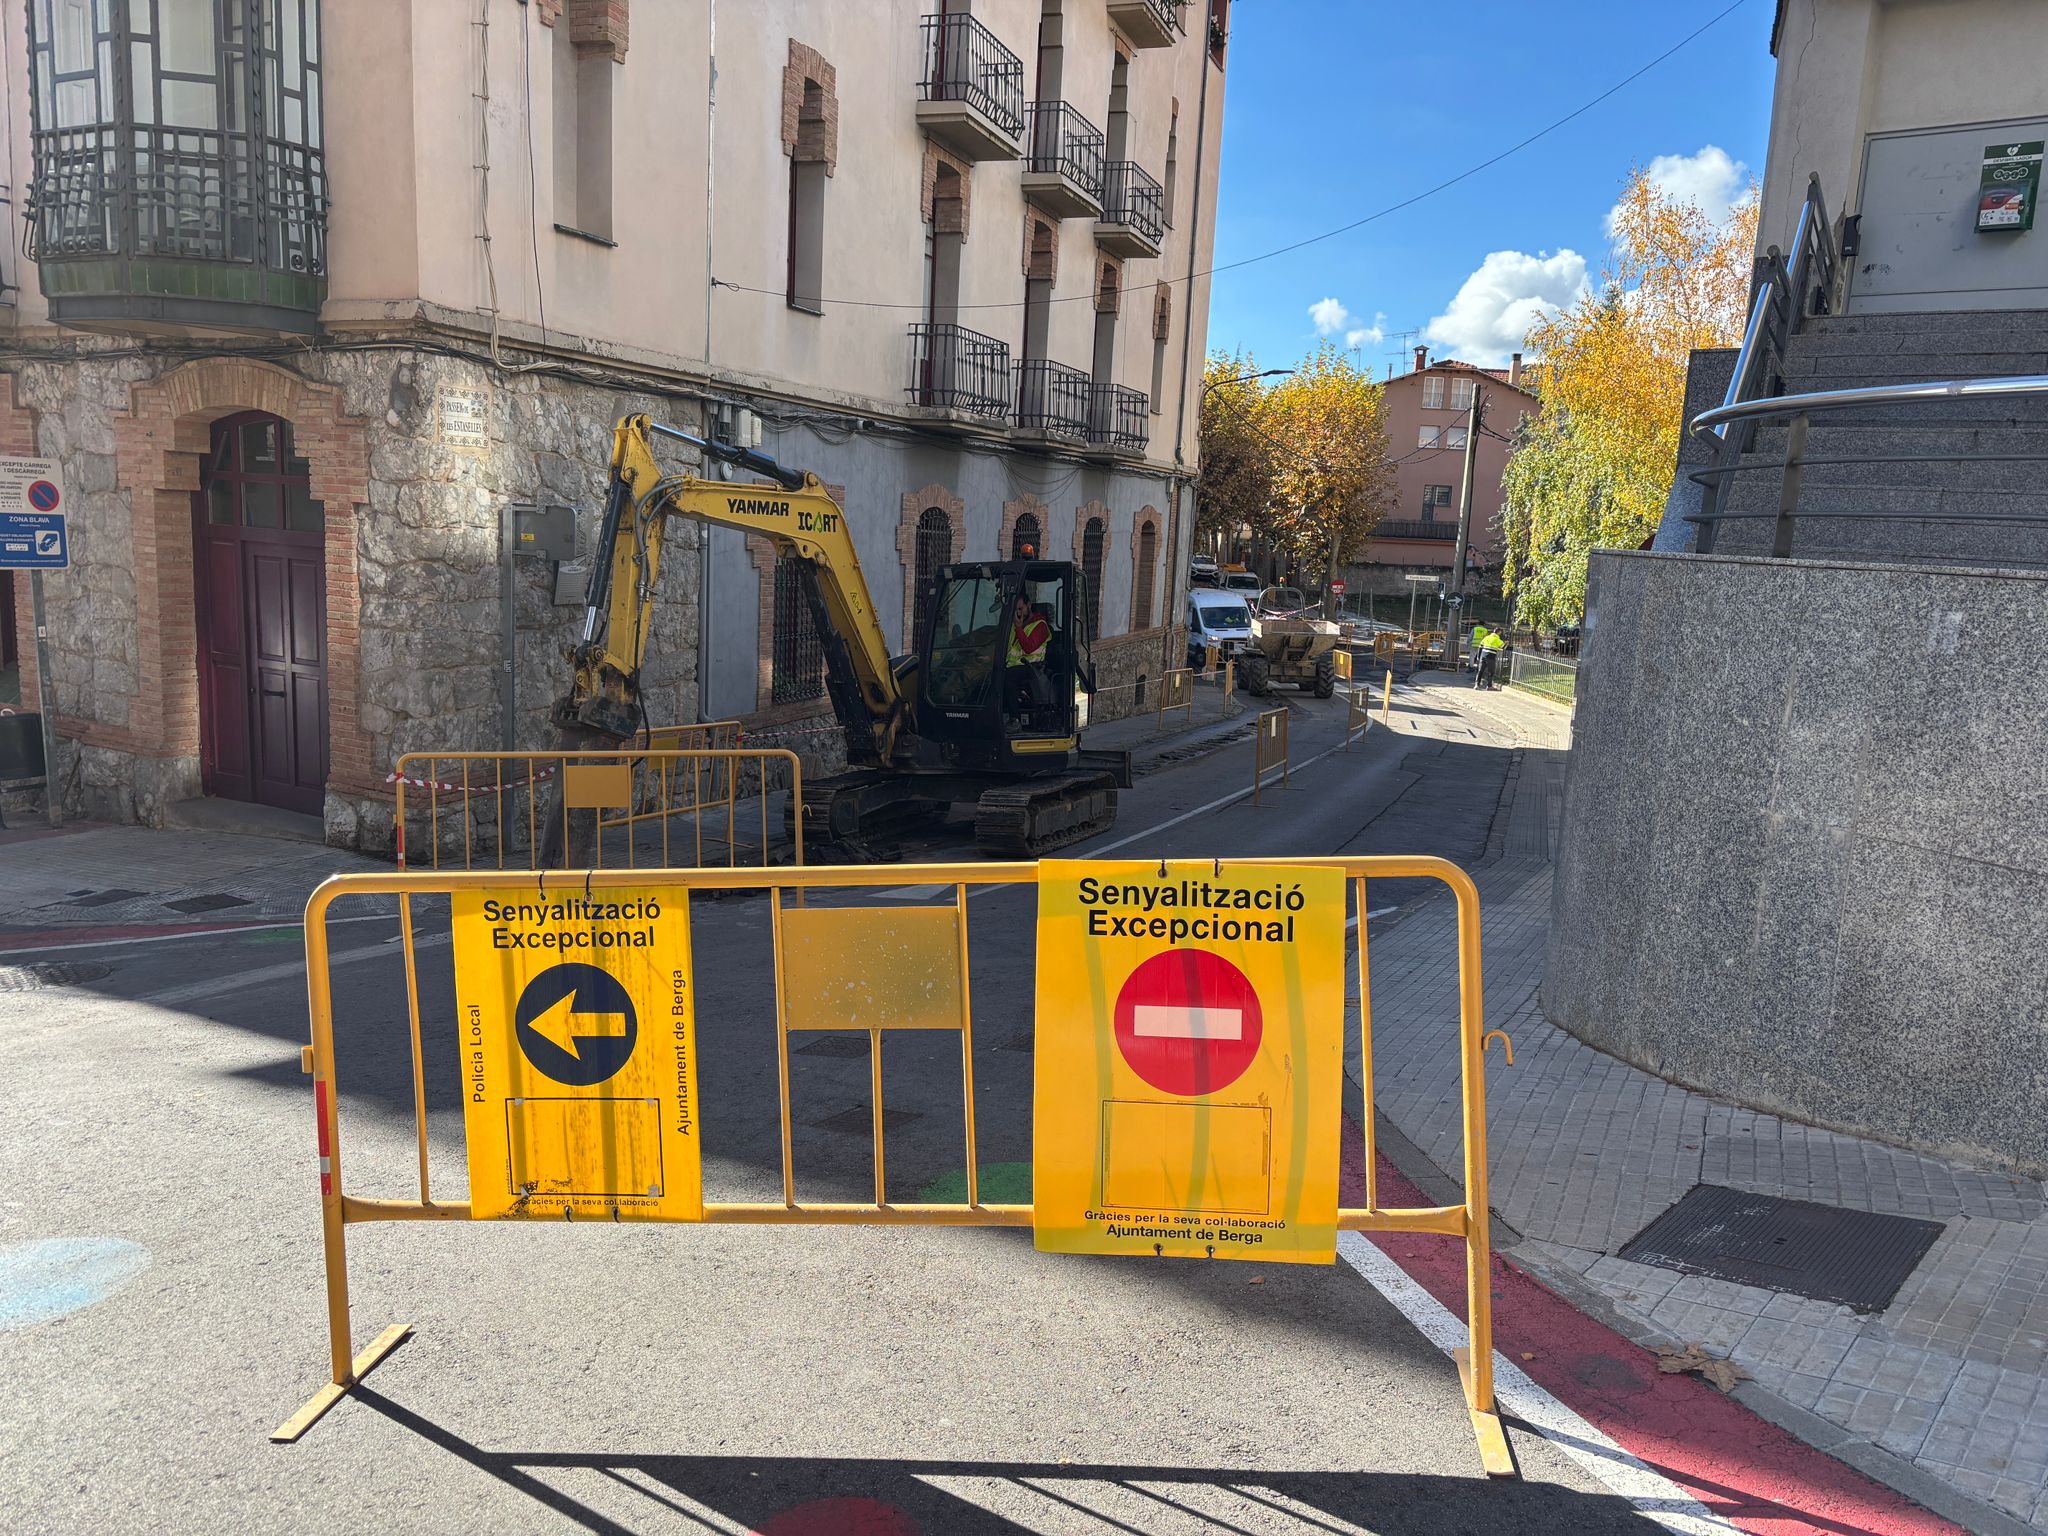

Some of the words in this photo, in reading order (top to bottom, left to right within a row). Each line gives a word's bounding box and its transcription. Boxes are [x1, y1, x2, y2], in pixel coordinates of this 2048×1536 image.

[727, 498, 790, 516] YANMAR
[798, 512, 838, 533] ICART
[1078, 878, 1305, 912] Senyalització
[483, 897, 661, 926] Senyalització
[492, 926, 655, 953] Excepcional
[1088, 909, 1294, 944] Excepcional
[672, 969, 686, 1016] Berga
[467, 1004, 482, 1046] Local
[673, 1021, 685, 1040] de
[471, 1051, 486, 1103] Policia
[674, 1045, 692, 1136] Ajuntament
[520, 1198, 554, 1206] ràcies
[555, 1198, 570, 1207] per
[572, 1198, 580, 1206] la
[1084, 1210, 1131, 1221] Gràcies
[1135, 1215, 1154, 1224] per
[1159, 1214, 1170, 1223] la
[1173, 1216, 1201, 1225] seva
[1106, 1224, 1192, 1240] Ajuntament
[1196, 1228, 1214, 1240] de
[1218, 1229, 1263, 1245] Berga
